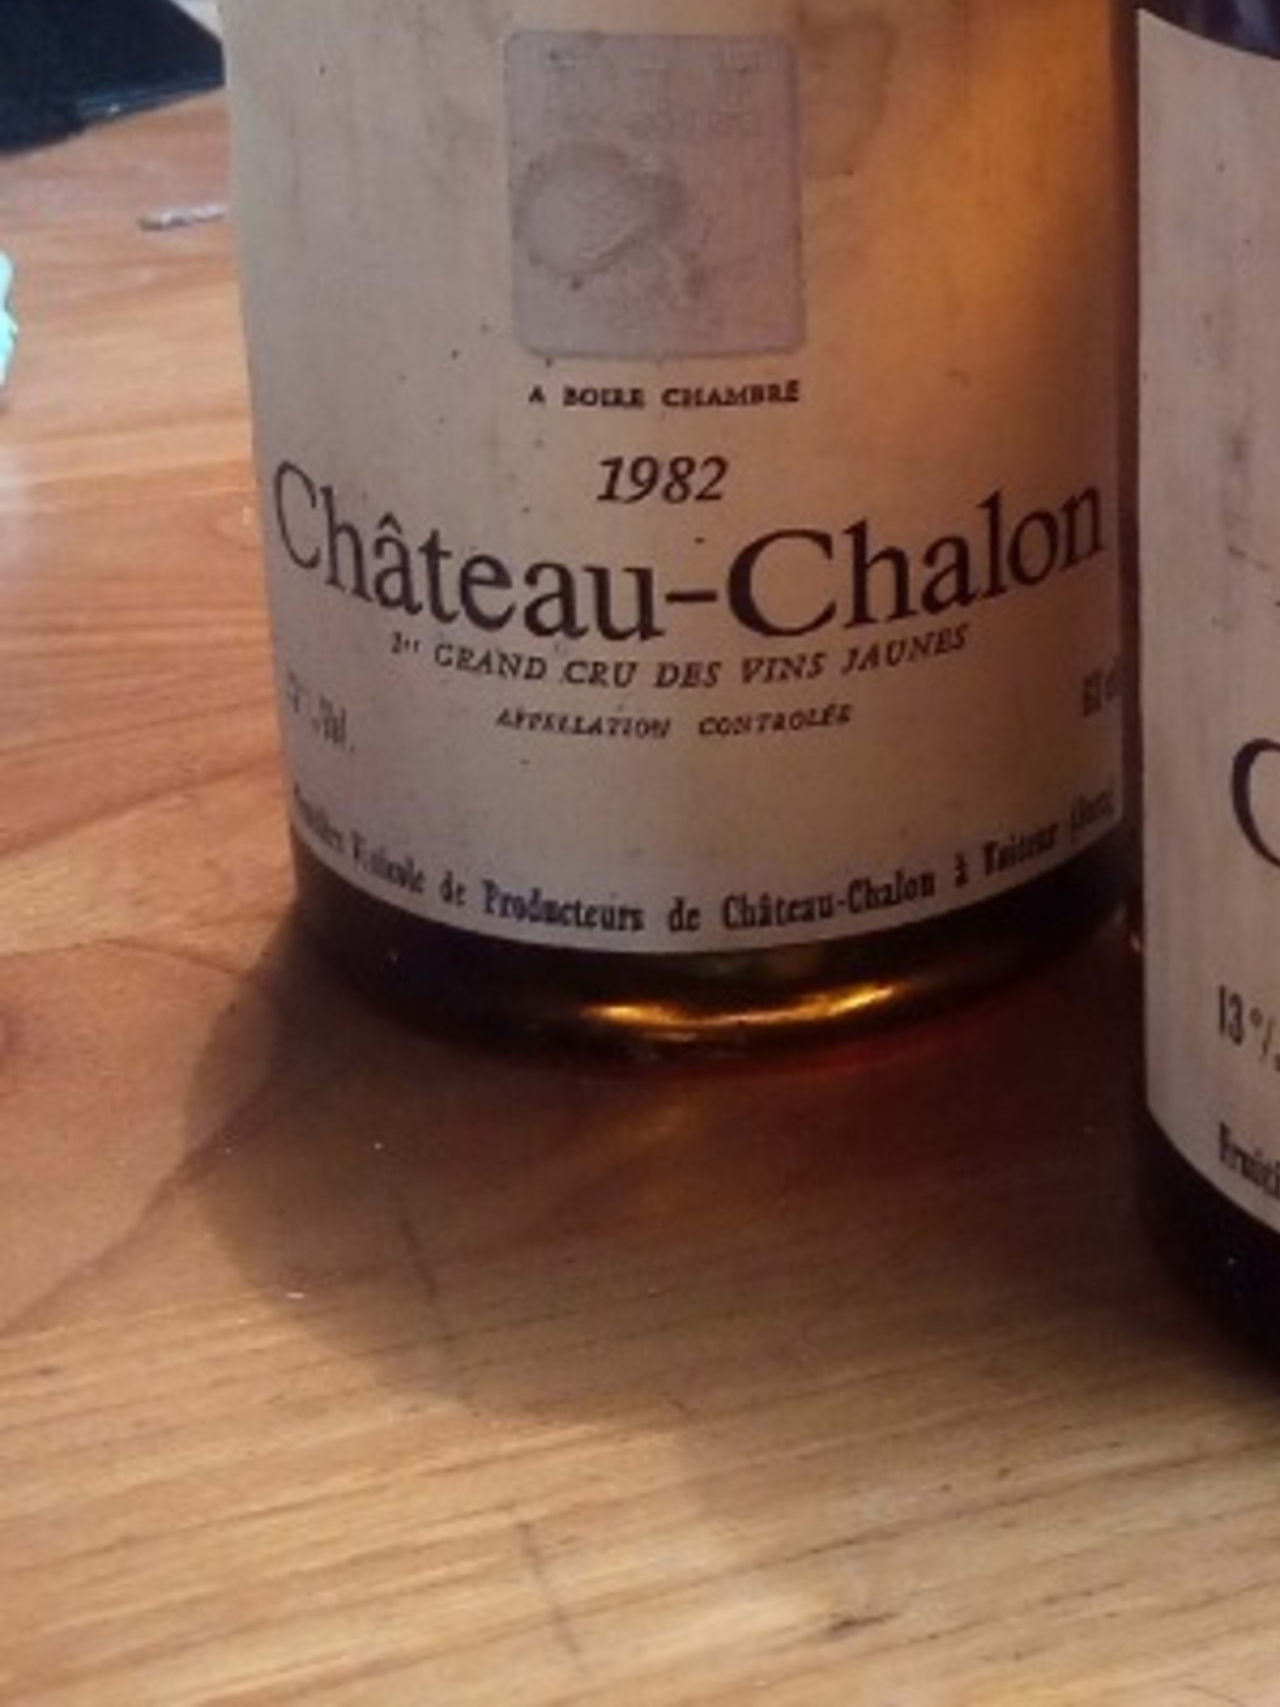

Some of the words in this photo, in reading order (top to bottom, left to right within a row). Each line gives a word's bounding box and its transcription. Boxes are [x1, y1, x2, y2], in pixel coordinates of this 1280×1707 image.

[529, 386, 546, 405] A
[563, 388, 645, 408] BOIRE
[662, 379, 799, 408] CHAMBRÉ
[597, 456, 728, 505] 1982
[274, 460, 1104, 642] Château-Chalon
[434, 644, 548, 681] GRAND
[564, 661, 637, 688] CRU
[655, 661, 721, 689] DES
[741, 652, 826, 685] VINS
[840, 623, 971, 676] JAUNES
[496, 707, 672, 740] APPELLATION
[439, 870, 467, 907] de
[482, 877, 646, 934] Producteurs
[668, 897, 701, 935] de
[722, 870, 937, 934] Château-Chalon
[954, 853, 970, 888] à
